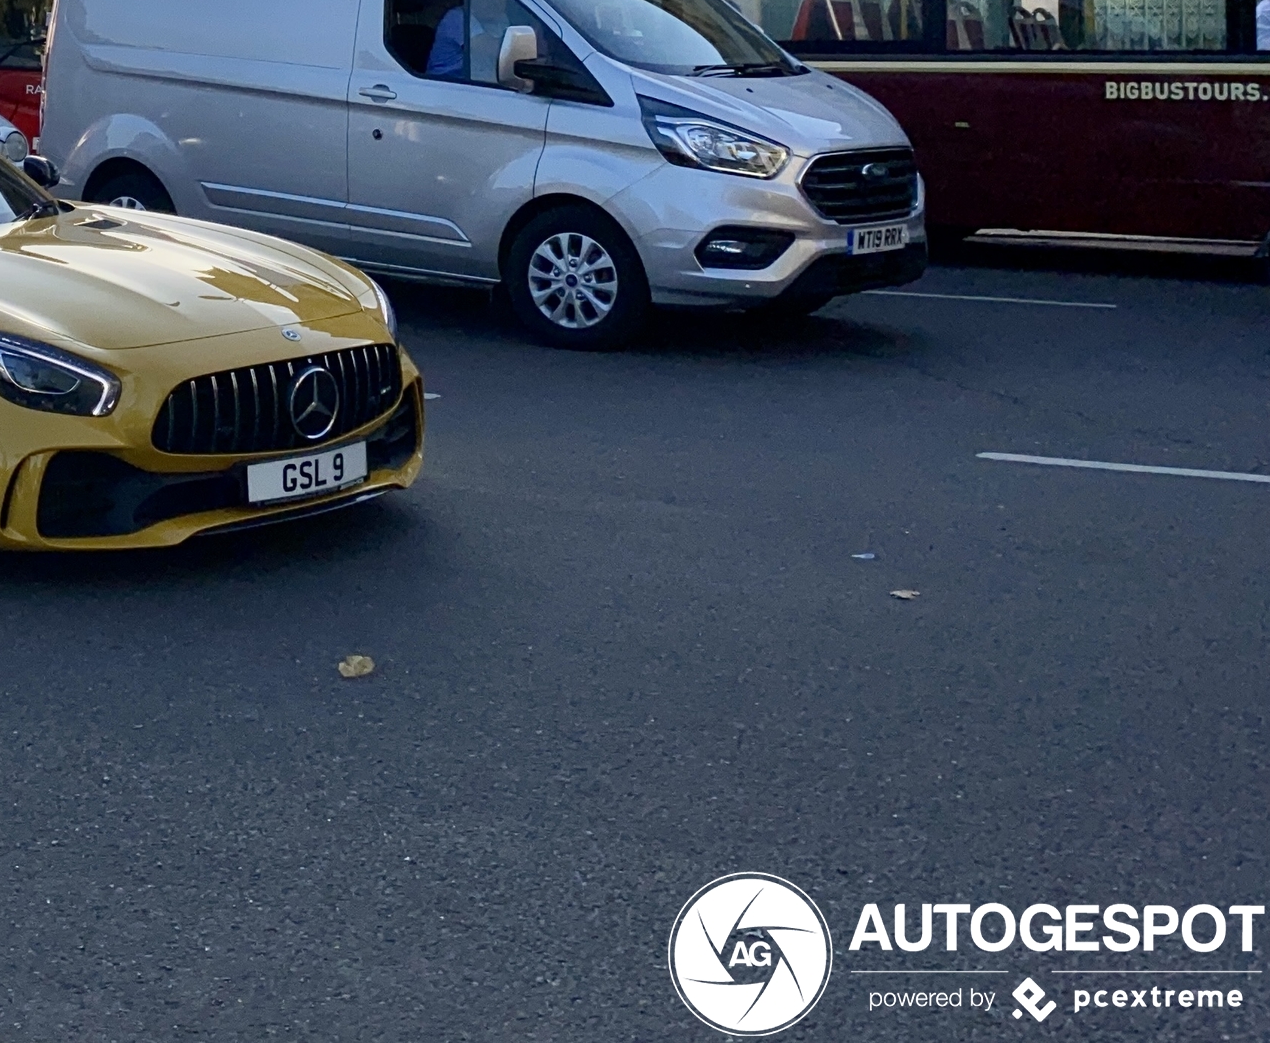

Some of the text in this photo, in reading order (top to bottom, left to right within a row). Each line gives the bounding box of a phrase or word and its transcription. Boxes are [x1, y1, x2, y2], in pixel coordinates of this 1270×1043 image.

[857, 226, 904, 251] WT19 RRX
[282, 452, 345, 493] GSL 9
